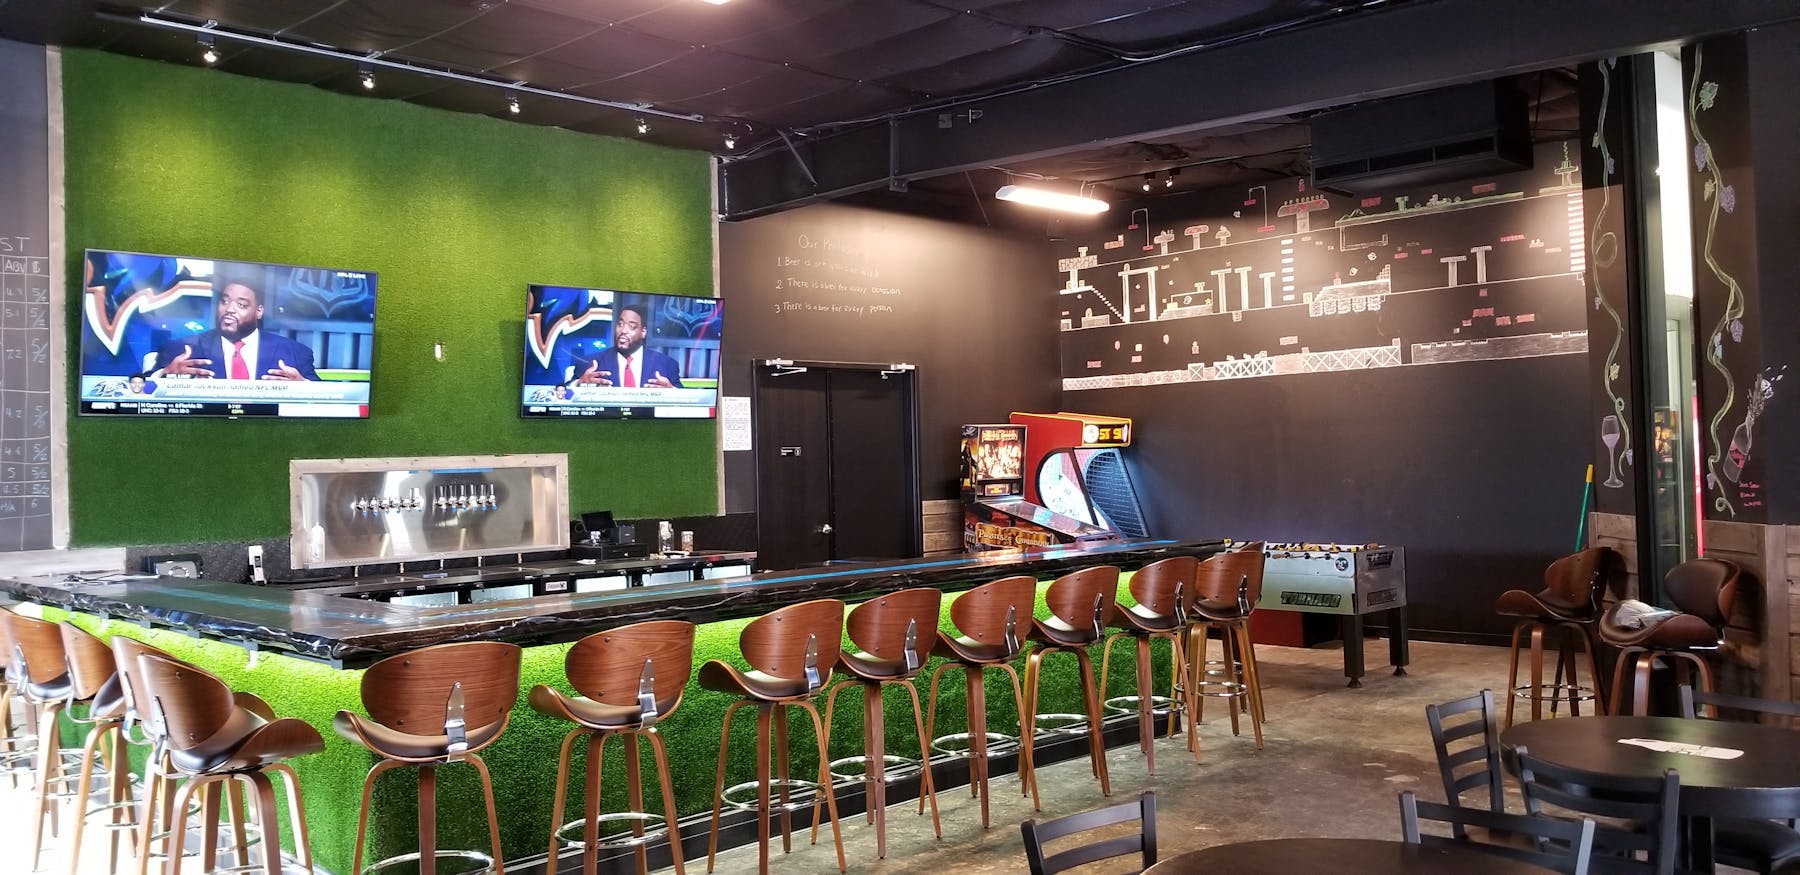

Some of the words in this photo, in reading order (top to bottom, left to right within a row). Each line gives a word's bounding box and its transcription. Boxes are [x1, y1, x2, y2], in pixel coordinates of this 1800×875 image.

[798, 233, 818, 249] Our
[4, 260, 25, 273] ABV
[784, 256, 800, 266] Beer
[787, 277, 809, 289] There
[783, 301, 802, 311] There
[870, 304, 893, 315] person
[7, 466, 16, 479] 5
